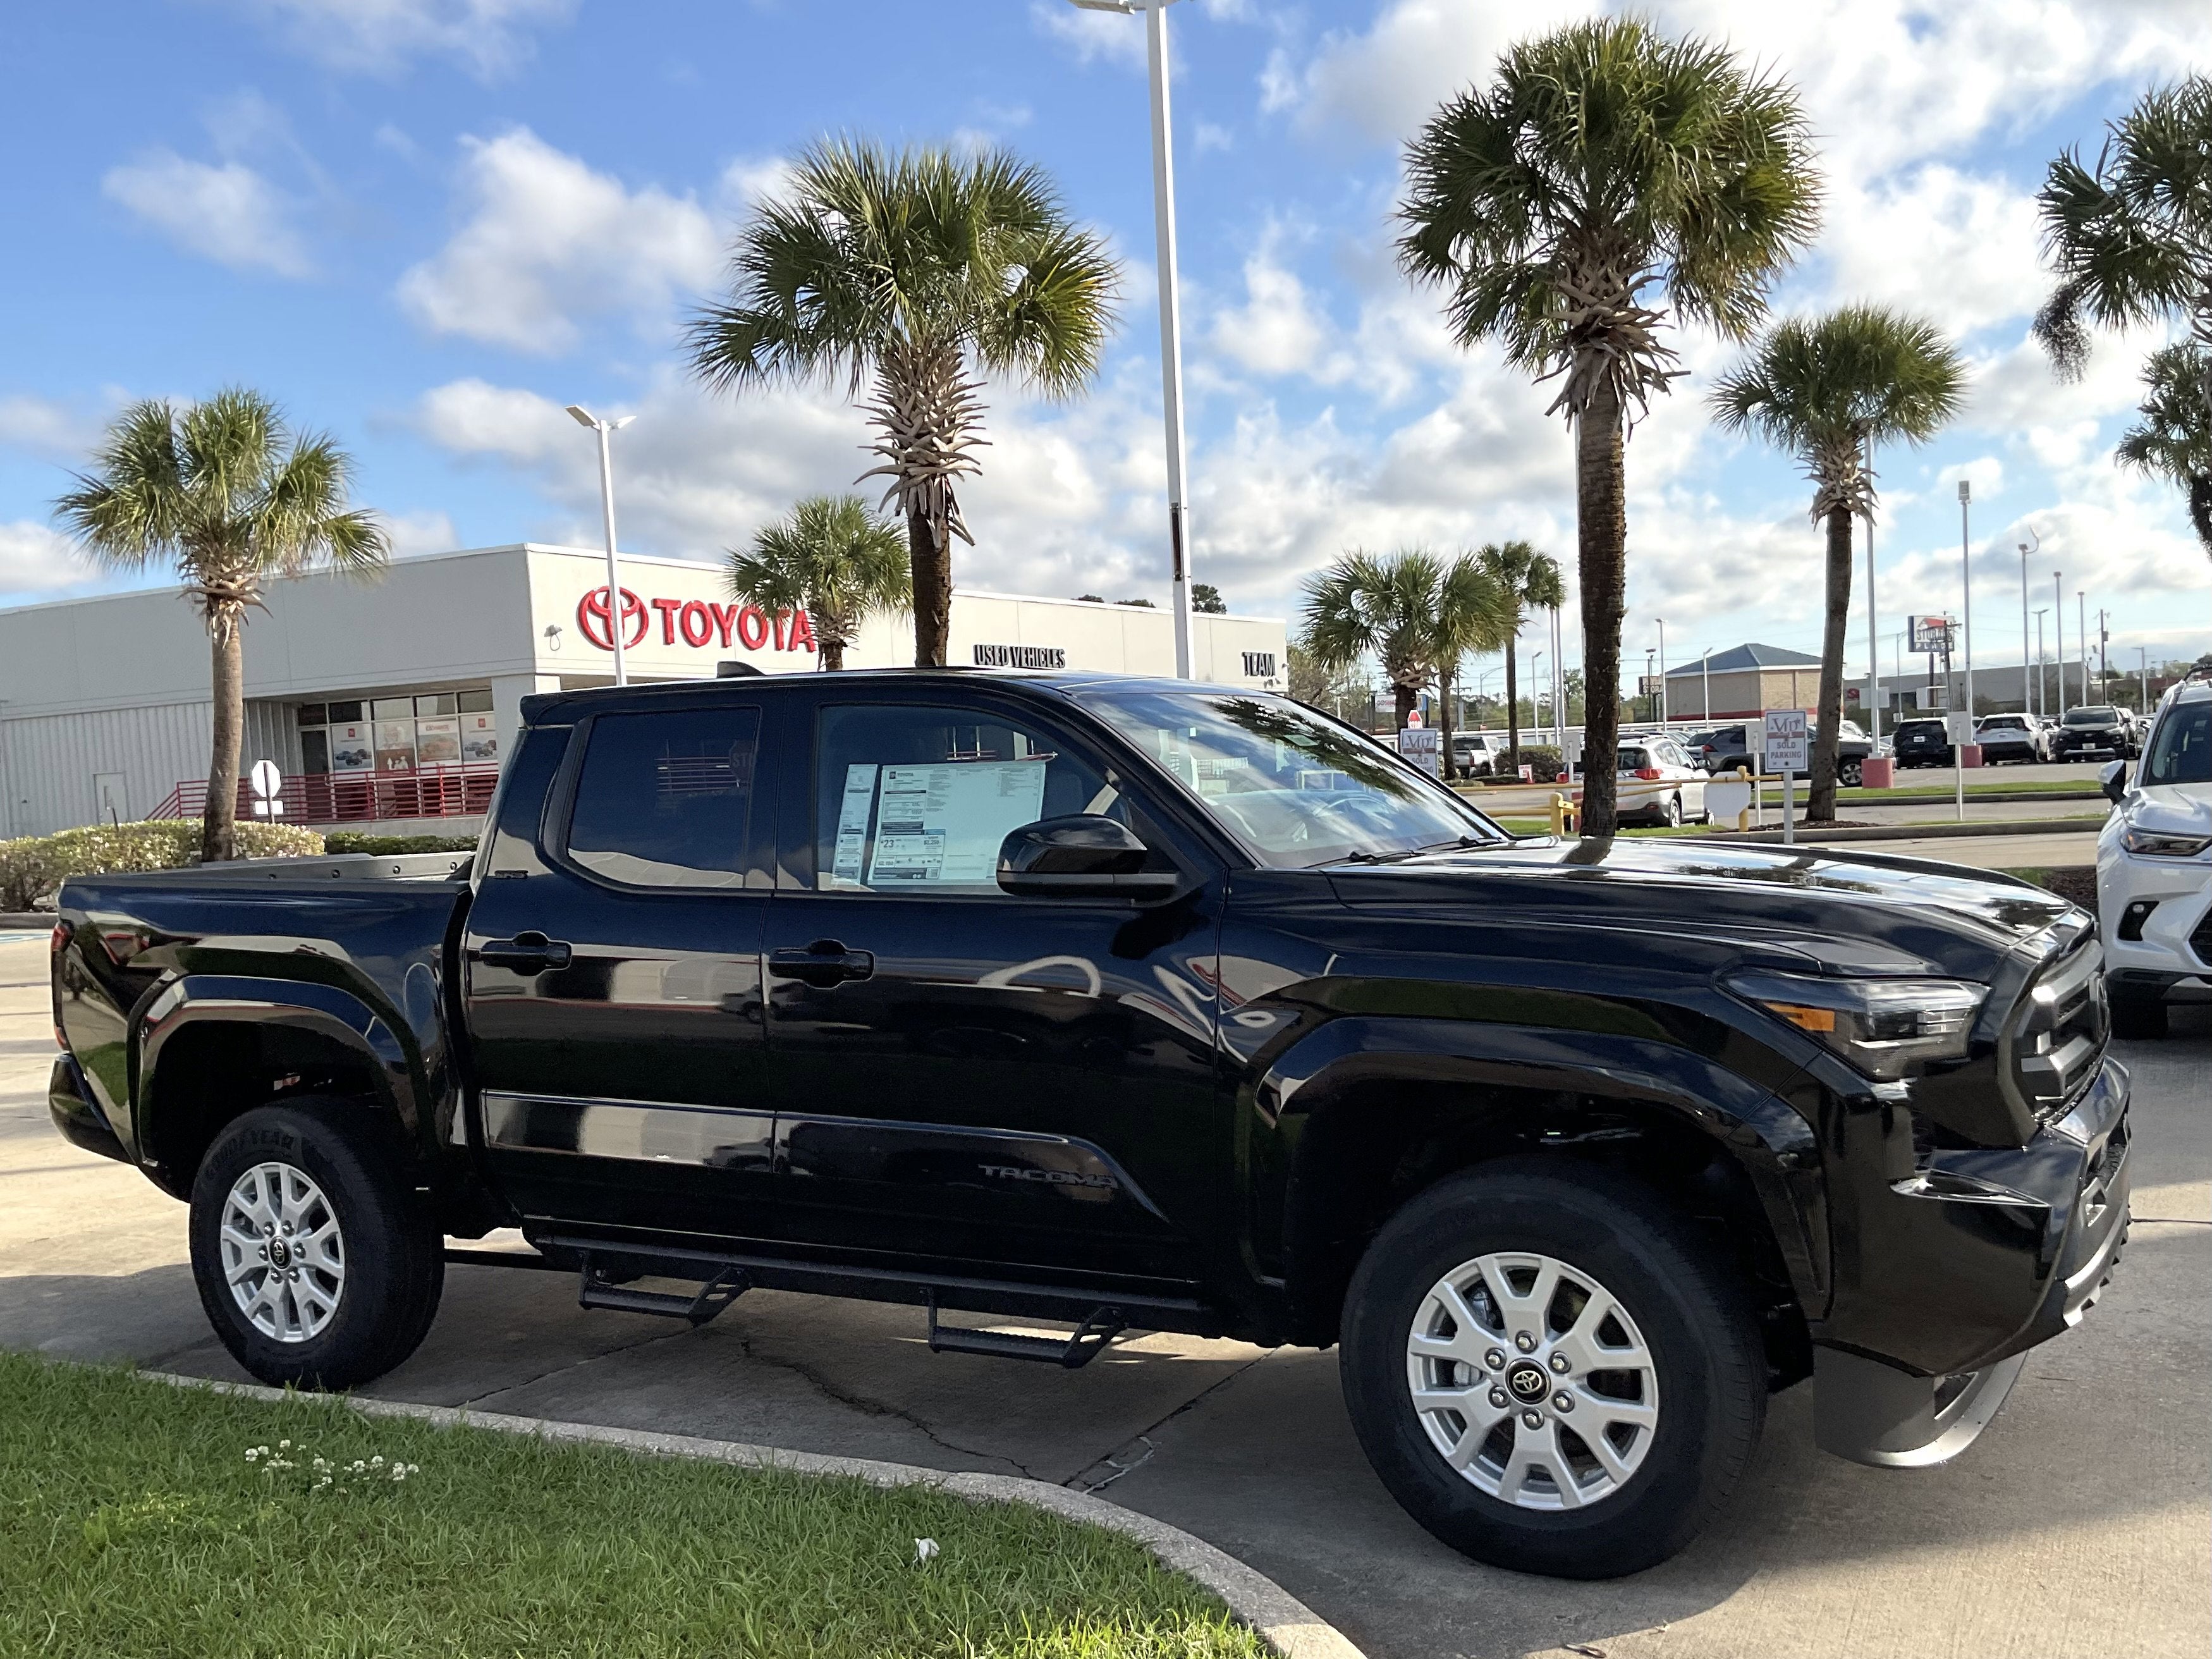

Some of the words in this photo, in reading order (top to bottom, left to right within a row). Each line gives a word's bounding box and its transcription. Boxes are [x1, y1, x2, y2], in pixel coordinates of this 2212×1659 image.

[651, 598, 817, 653] TOYOTA
[973, 644, 1008, 666] USED
[1009, 646, 1066, 668] VEHICLES
[1242, 652, 1275, 676] TEAM
[884, 840, 894, 848] 23
[978, 1165, 1119, 1189] TACOMA
